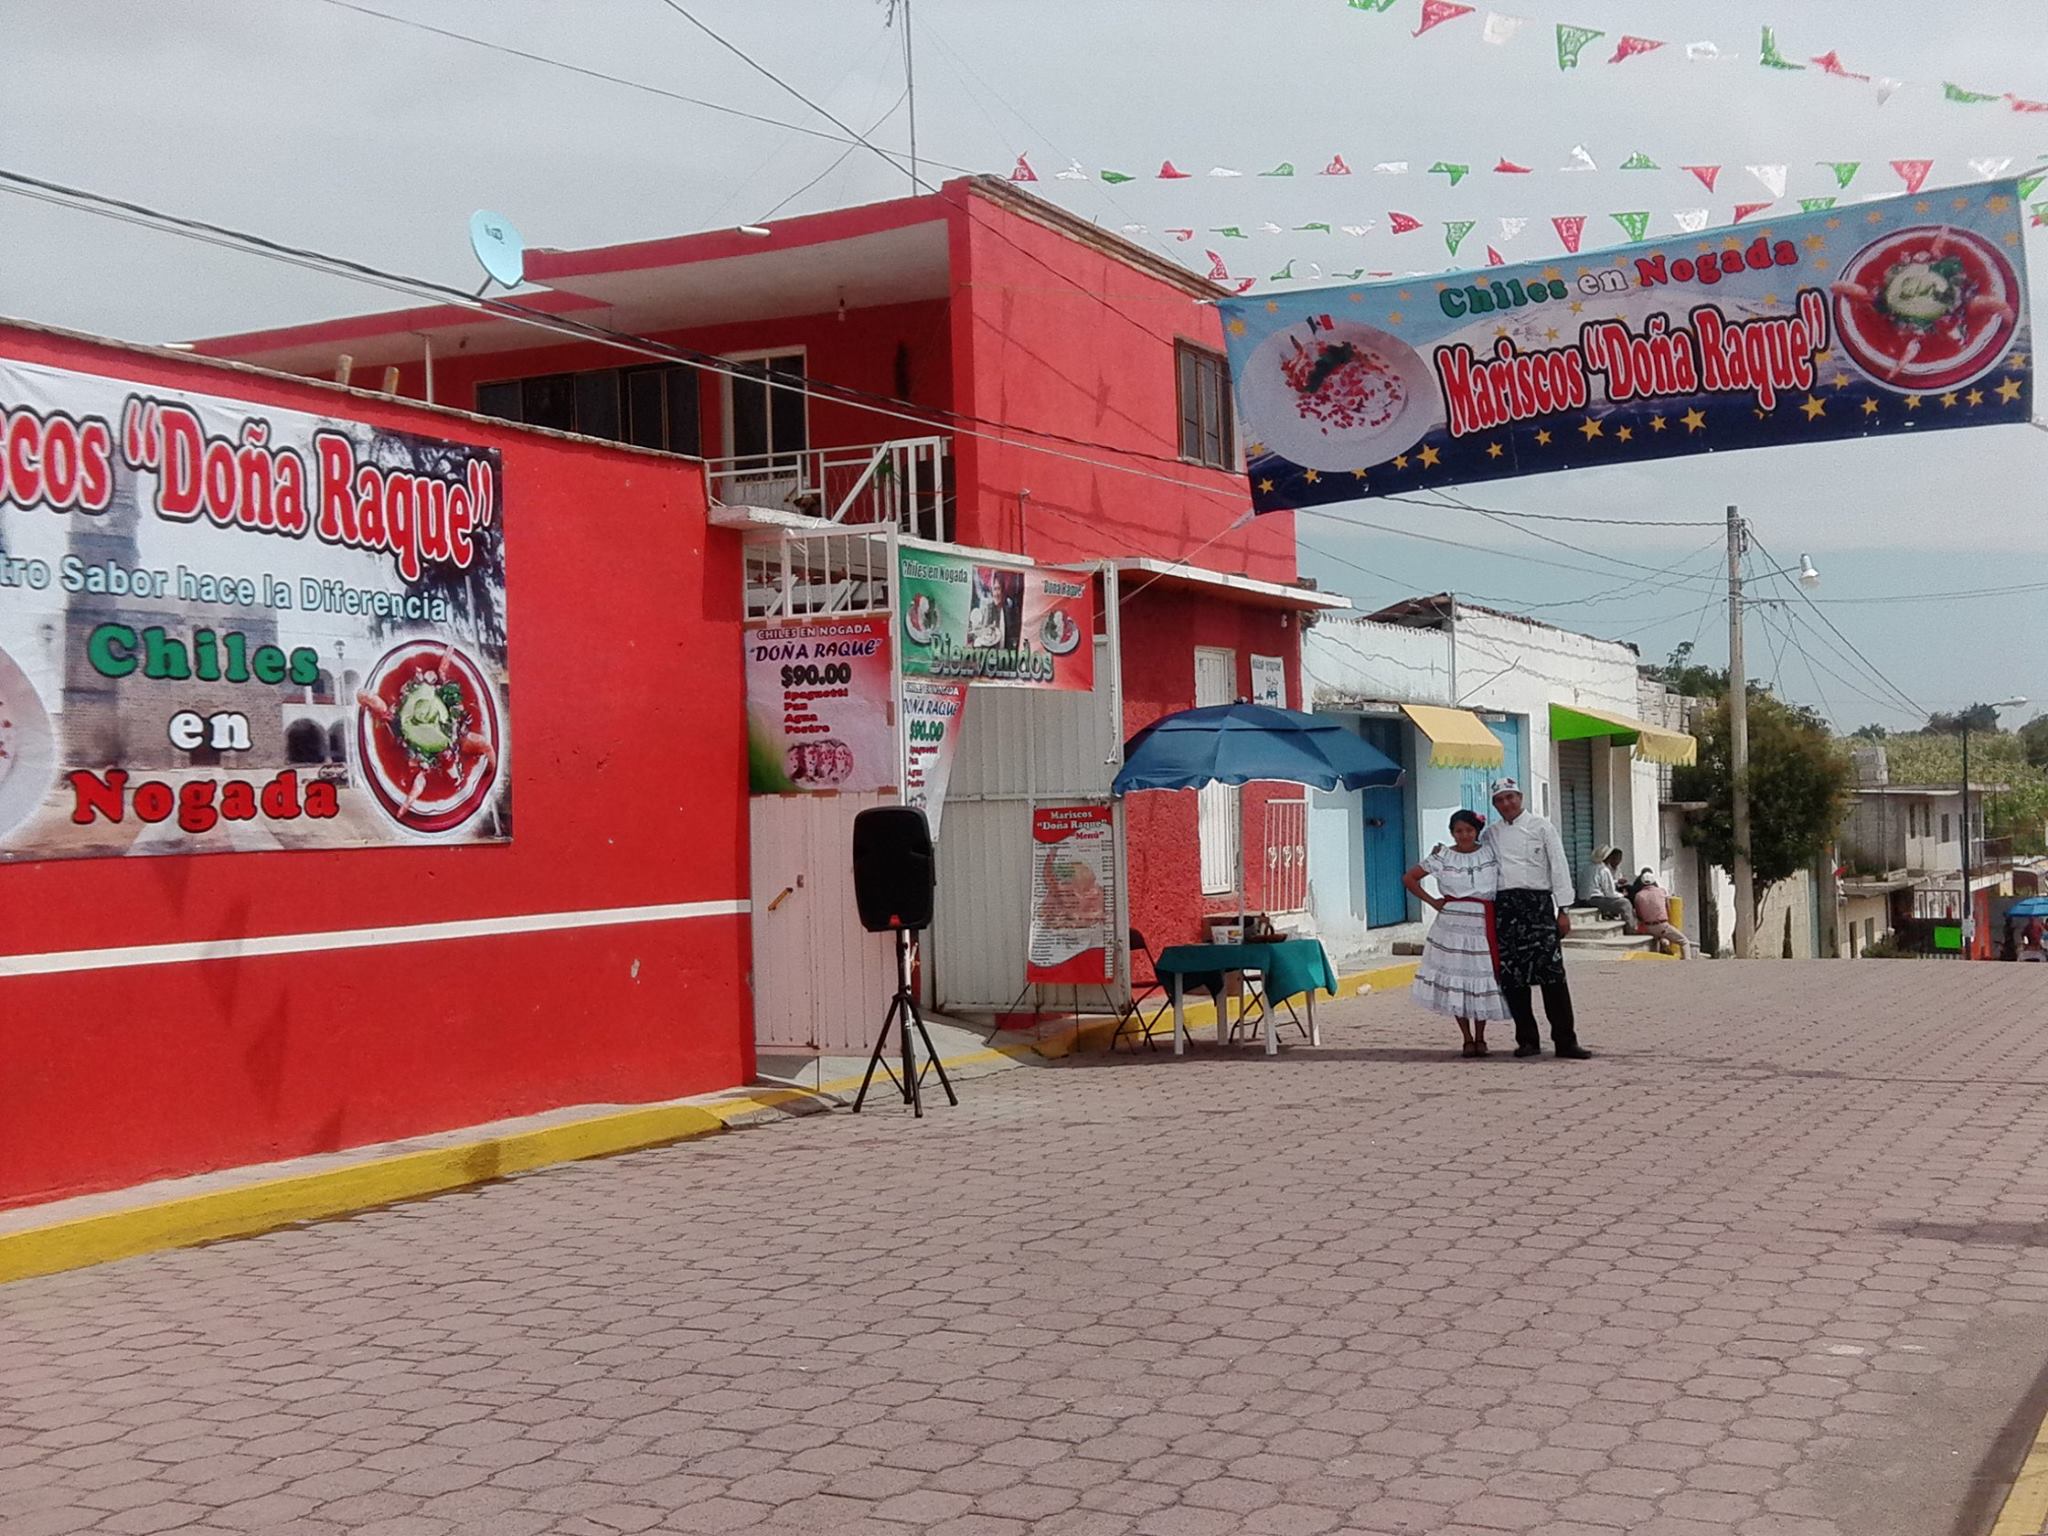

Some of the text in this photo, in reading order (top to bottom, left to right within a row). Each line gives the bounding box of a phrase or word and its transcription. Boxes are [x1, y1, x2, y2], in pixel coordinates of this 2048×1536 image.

[1440, 237, 1799, 318] Chiles en Nogada
[1434, 288, 1831, 440] Mariscos "Doña Raque"
[0, 395, 494, 582] cos "Doña Raque"
[60, 554, 168, 598] Sabor
[178, 565, 255, 606] hace
[264, 574, 292, 609] la
[300, 577, 448, 622] Diferencia
[88, 624, 319, 685] Chiles
[757, 624, 872, 641] CHILES EN NOGADA
[930, 633, 1054, 680] Bienvenidos
[781, 662, 851, 688] $90.00
[167, 709, 253, 751] en
[784, 714, 818, 724] Agua
[69, 769, 339, 832] Nogada
[1050, 810, 1092, 819] Mariscos
